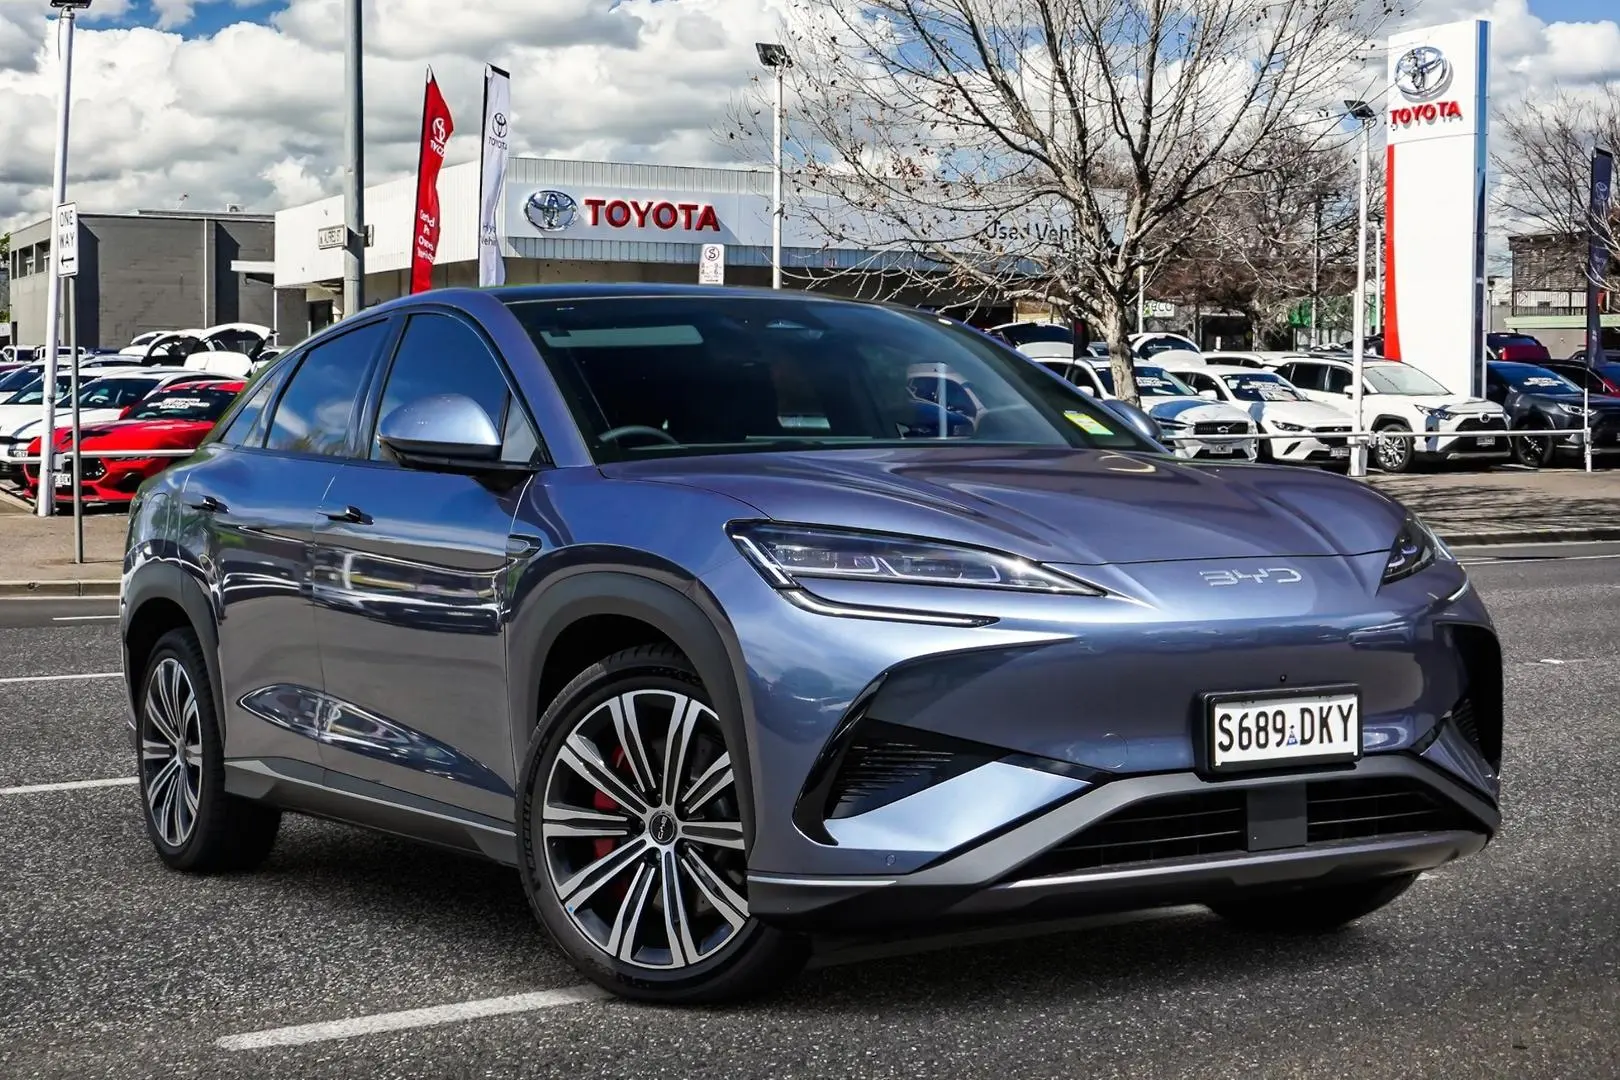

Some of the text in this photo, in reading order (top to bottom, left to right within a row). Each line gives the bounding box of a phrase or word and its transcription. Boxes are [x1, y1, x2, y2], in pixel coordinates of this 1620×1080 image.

[1390, 101, 1463, 125] TOYOTA
[489, 136, 508, 150] TOYOTA
[60, 209, 74, 228] ONE
[584, 199, 721, 232] TOYOTA
[60, 232, 75, 248] WAY
[985, 220, 1030, 240] Used
[1200, 567, 1303, 587] BYD
[1217, 703, 1354, 753] S689 DKY
